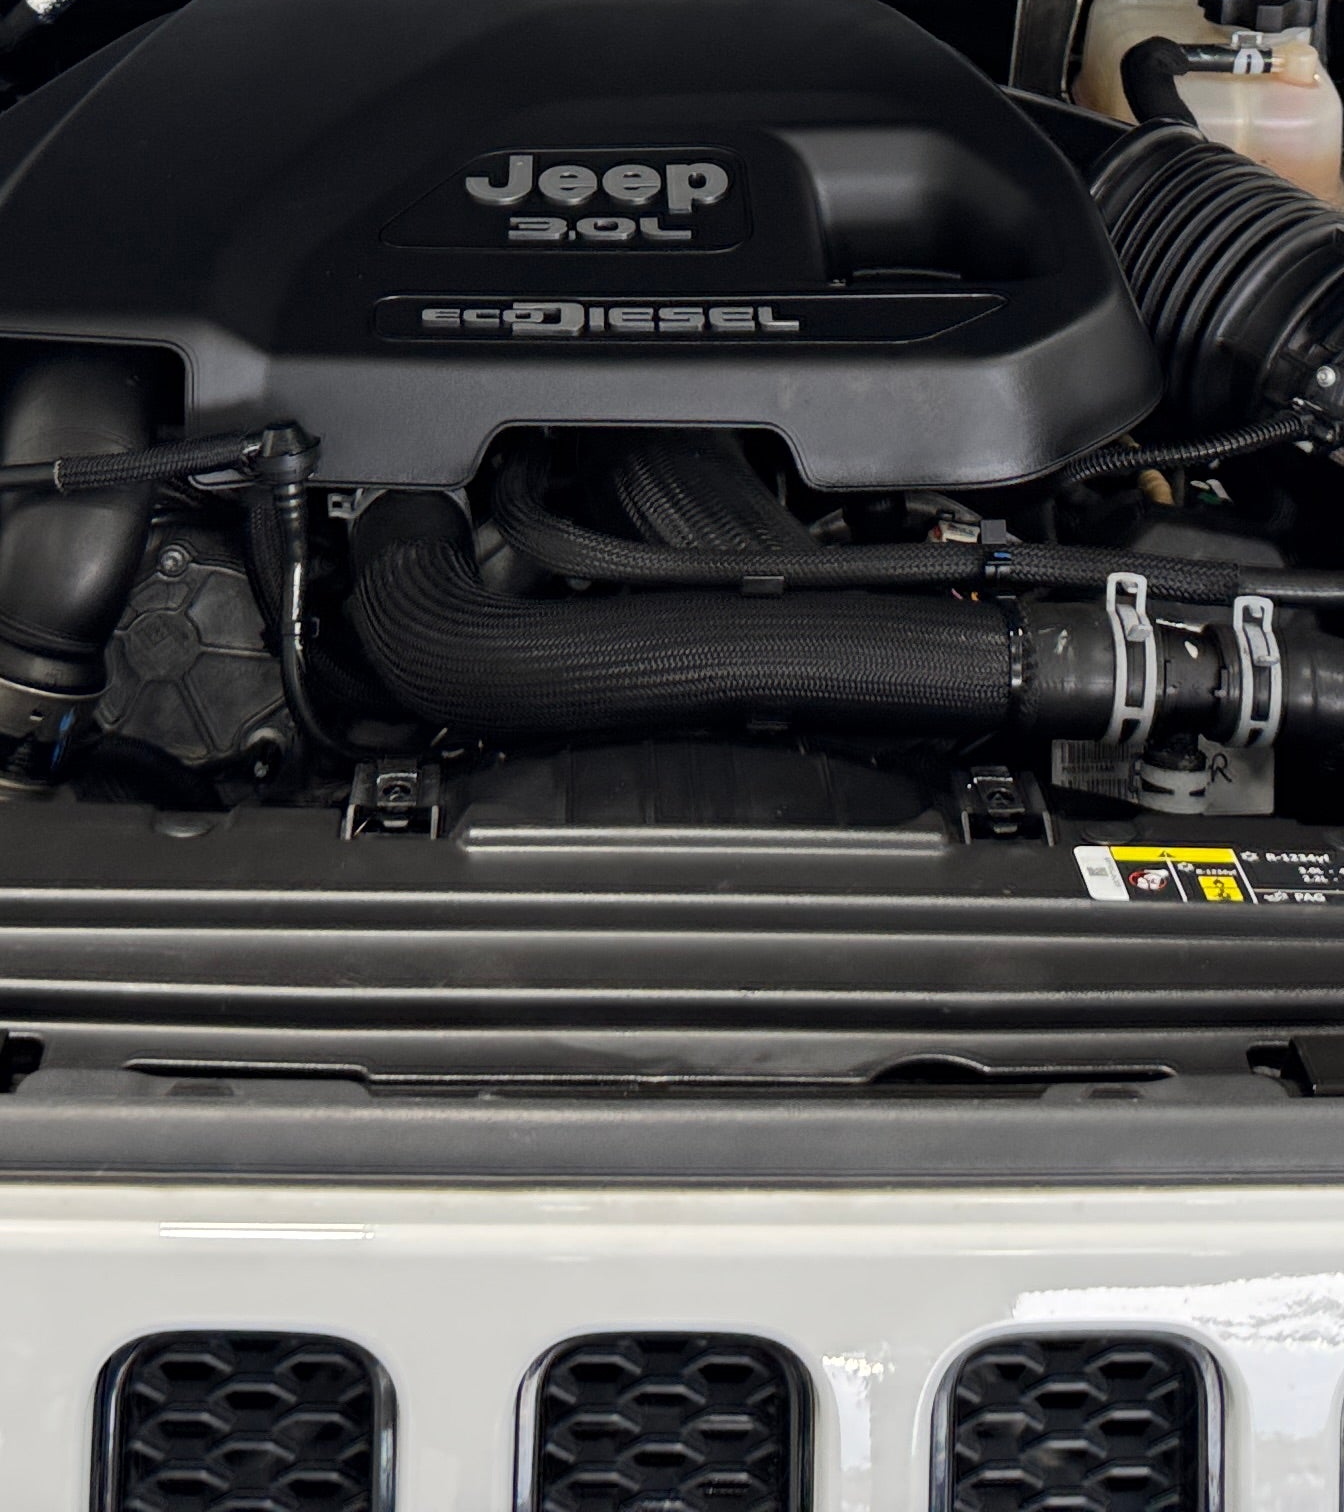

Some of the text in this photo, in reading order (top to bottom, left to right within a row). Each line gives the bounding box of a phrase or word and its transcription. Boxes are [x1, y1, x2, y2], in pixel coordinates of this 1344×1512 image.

[466, 155, 728, 213] Jeep
[508, 217, 692, 240] 3.0L
[1294, 892, 1327, 903] PAG
